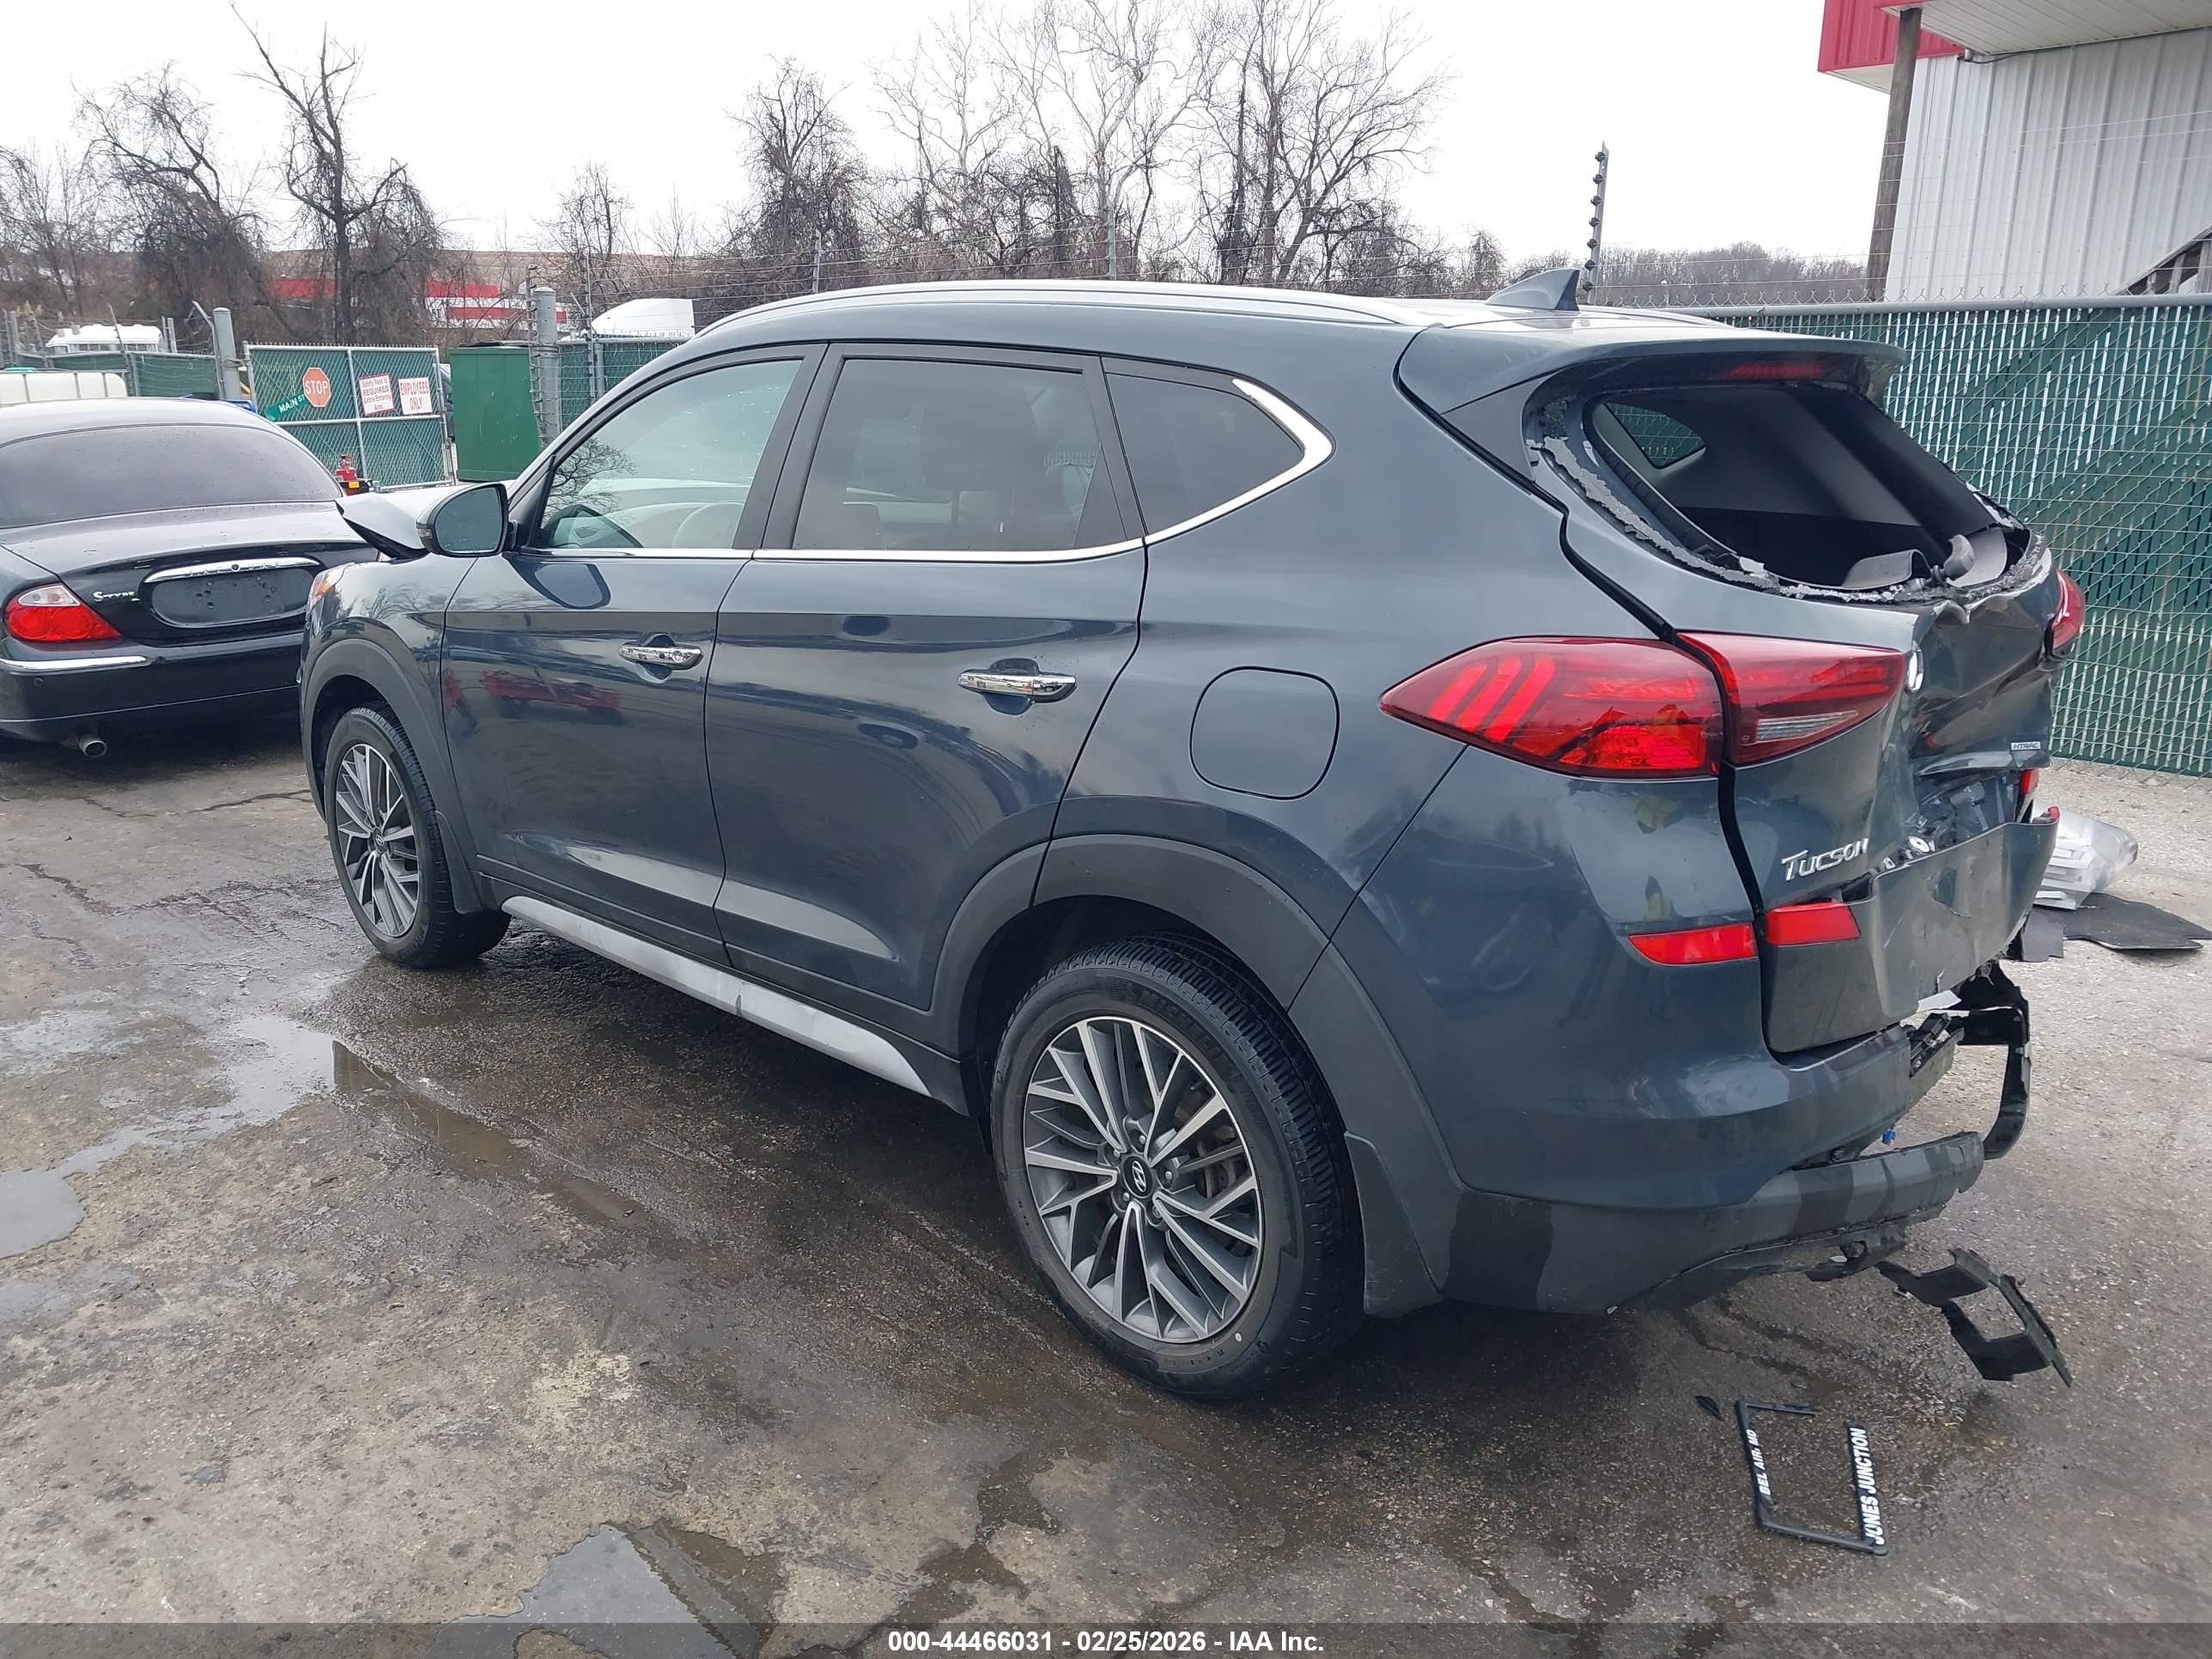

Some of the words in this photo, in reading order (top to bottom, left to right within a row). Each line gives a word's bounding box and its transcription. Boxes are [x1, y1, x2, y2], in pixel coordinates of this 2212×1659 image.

[305, 380, 328, 395] STOP
[363, 386, 389, 396] REQUIRED
[400, 380, 429, 396] EMPLOYEES
[278, 398, 299, 413] MAIN
[297, 394, 306, 403] ST
[409, 397, 422, 410] ONLY
[1746, 1429, 1759, 1446] MD
[1850, 1427, 1877, 1494] JUNCTION
[1756, 1472, 1771, 1496] BEL
[1859, 1495, 1885, 1545] JONES
